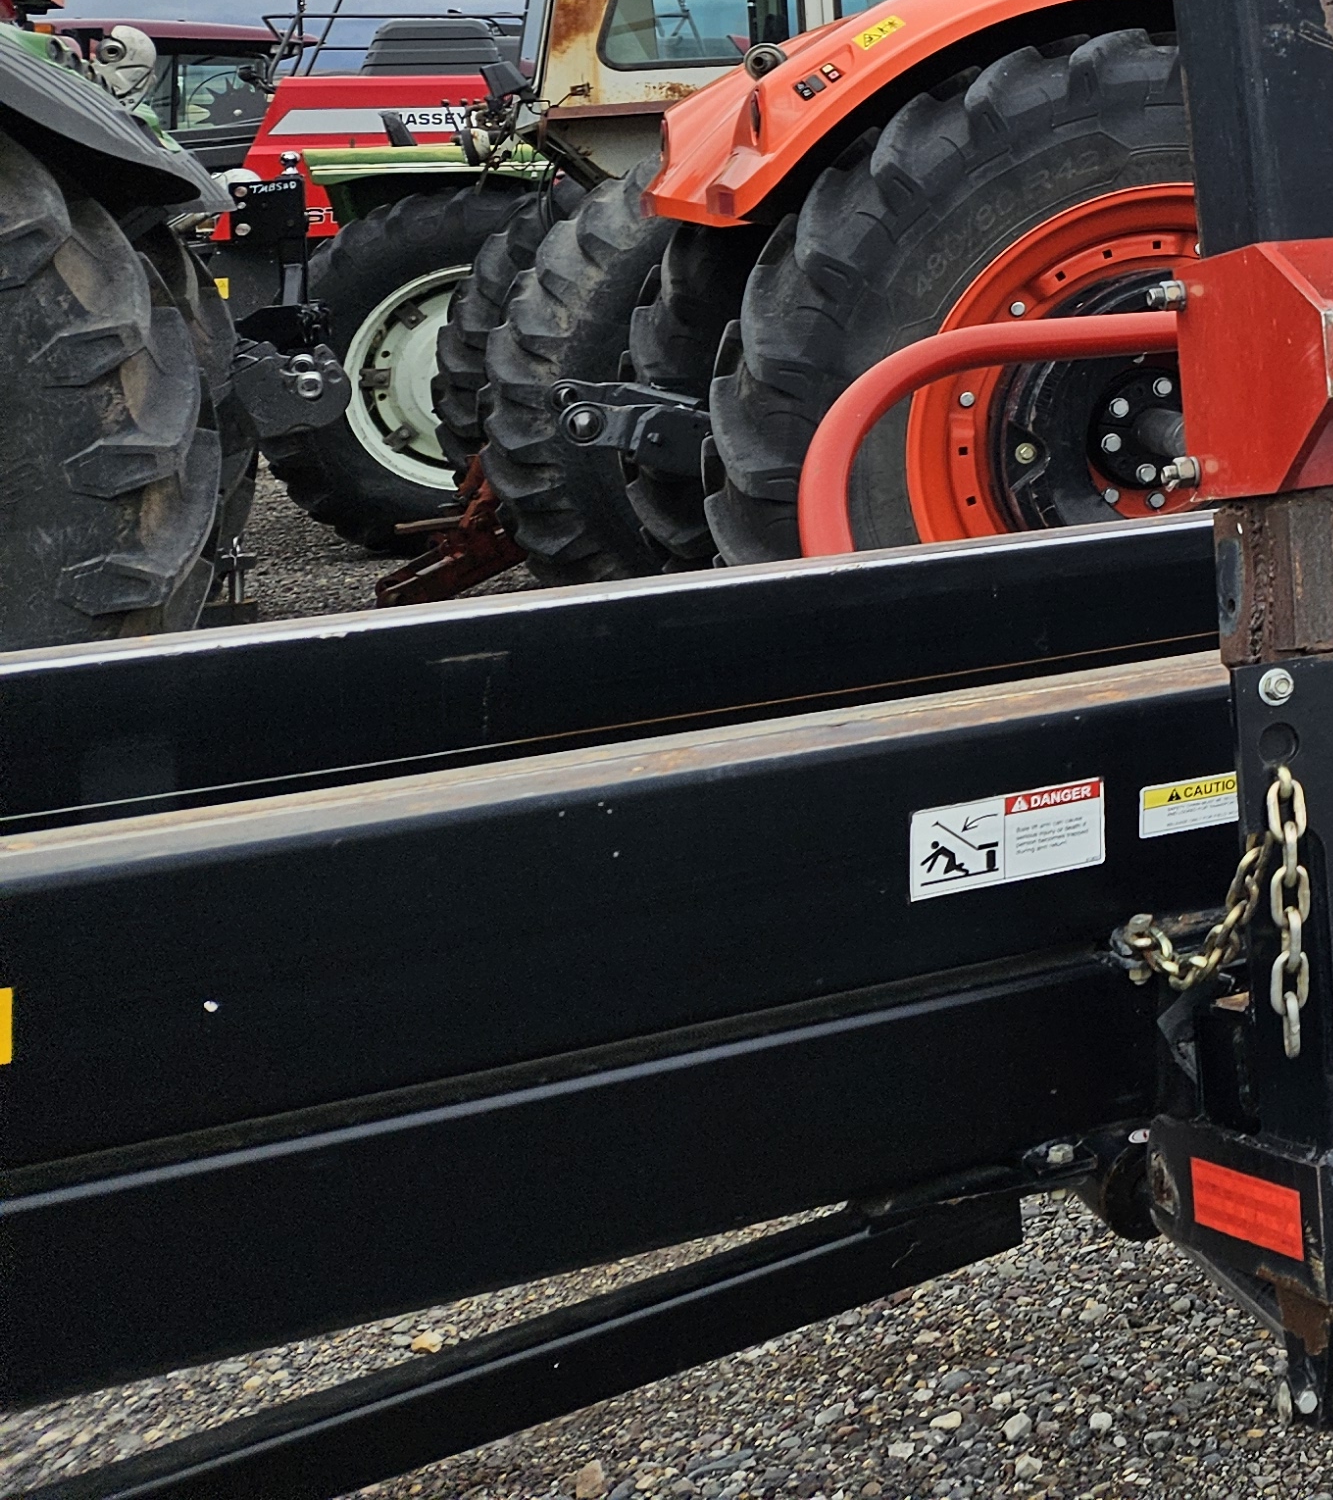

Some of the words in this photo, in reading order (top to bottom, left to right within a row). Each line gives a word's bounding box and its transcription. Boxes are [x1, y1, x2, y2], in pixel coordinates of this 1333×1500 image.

[399, 113, 467, 126] ASSEY
[1030, 785, 1092, 809] DANGER
[1184, 779, 1236, 798] CAUTIO
